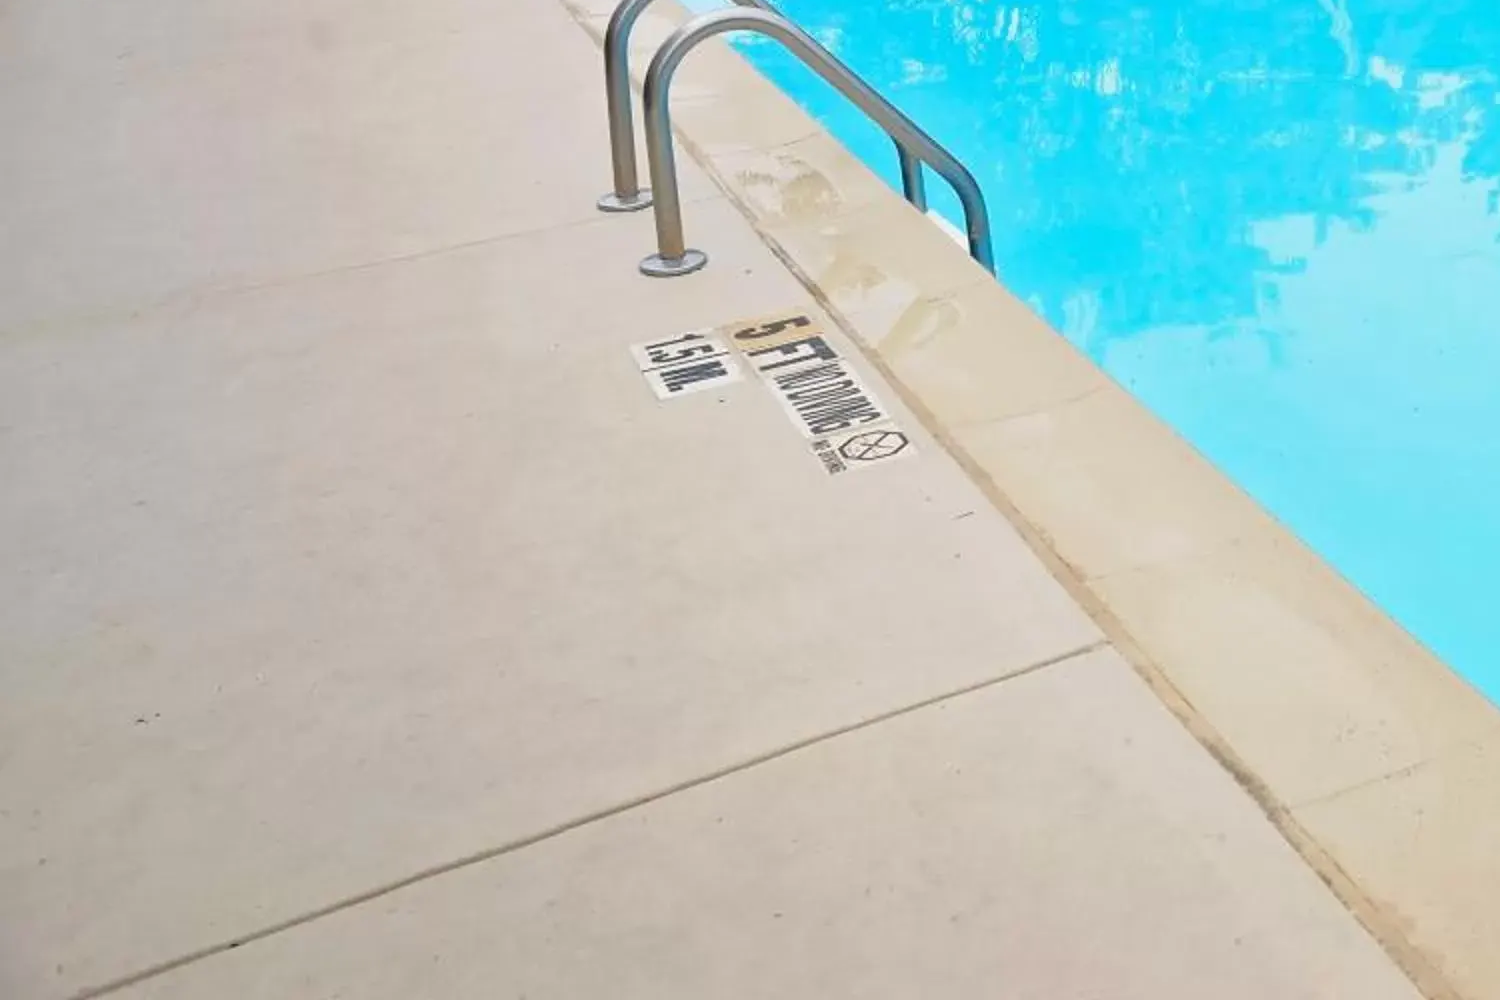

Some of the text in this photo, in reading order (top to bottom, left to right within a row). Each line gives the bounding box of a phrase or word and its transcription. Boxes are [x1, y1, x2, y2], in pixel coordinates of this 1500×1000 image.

[733, 315, 882, 435] 5 FT NO DIVING
